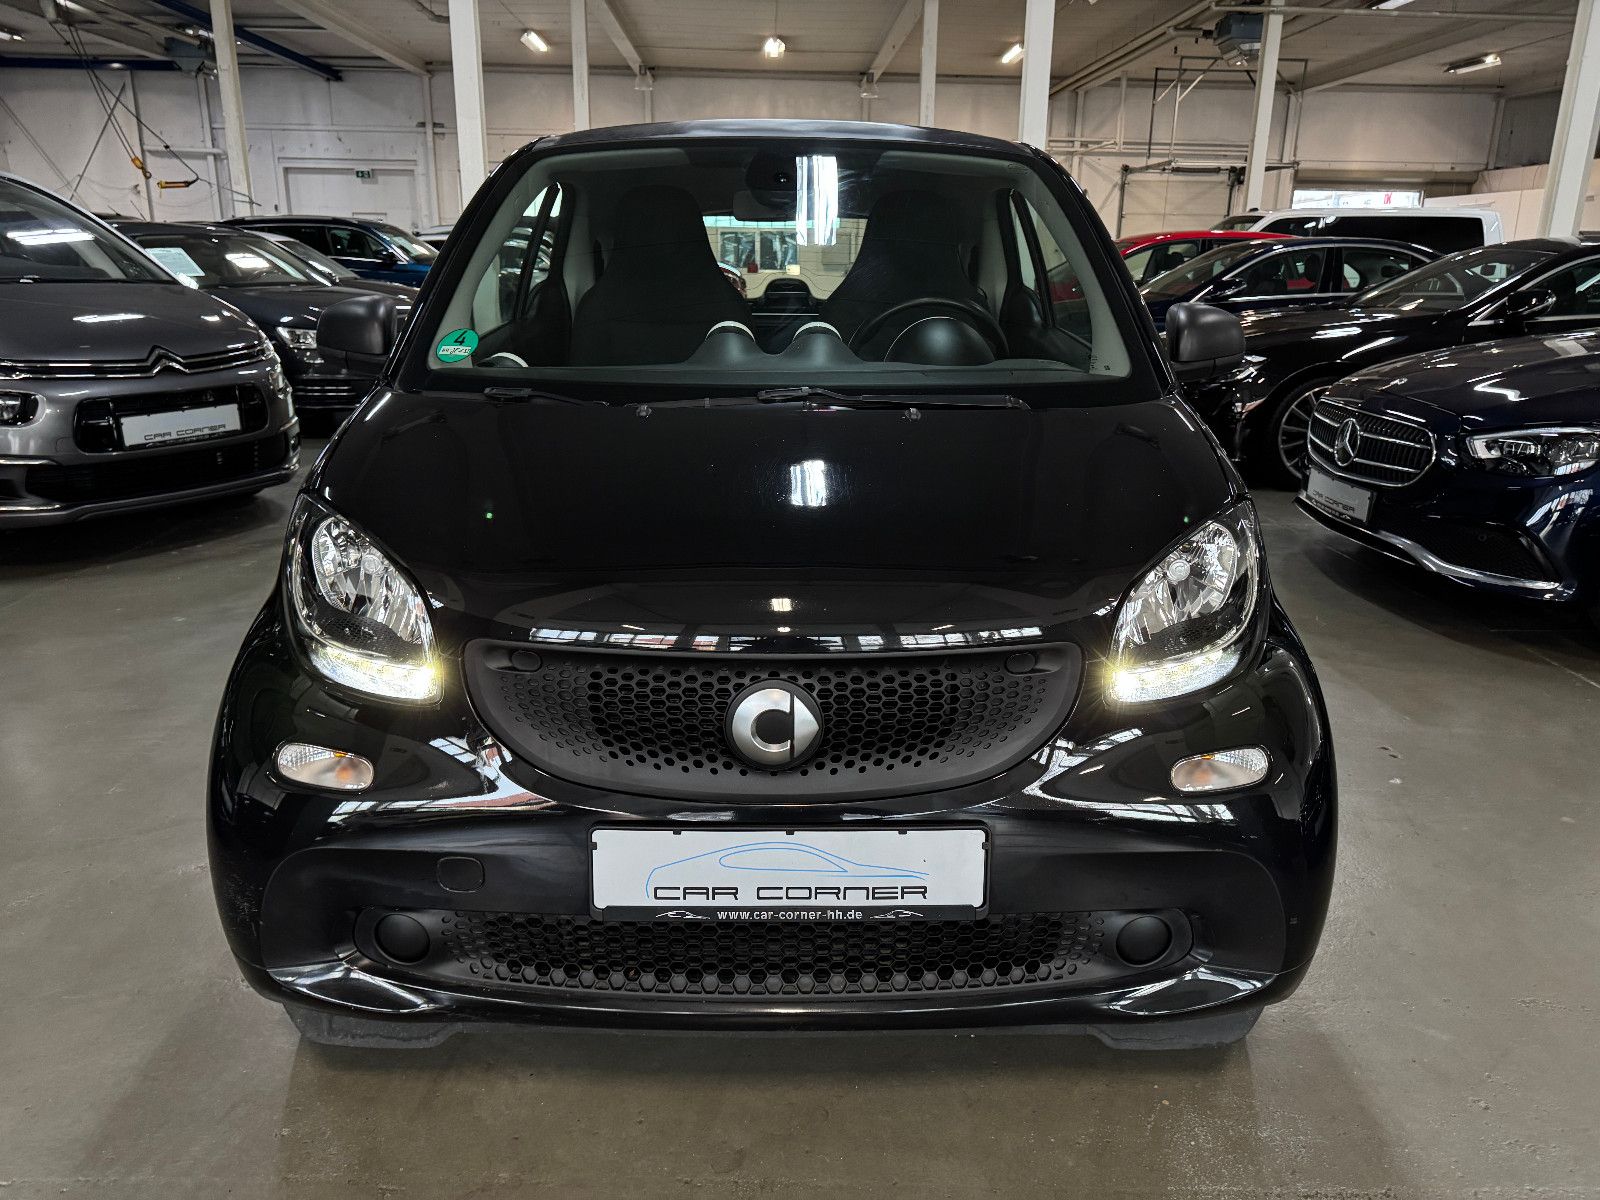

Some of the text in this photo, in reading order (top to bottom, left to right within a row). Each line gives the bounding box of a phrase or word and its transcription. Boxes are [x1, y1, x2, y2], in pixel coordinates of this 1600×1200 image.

[454, 330, 467, 346] 4
[144, 431, 172, 441] CAR
[176, 423, 226, 437] CORNER
[653, 885, 928, 901] CAR CORNER
[716, 909, 863, 920] www.car-corner-hh.de
